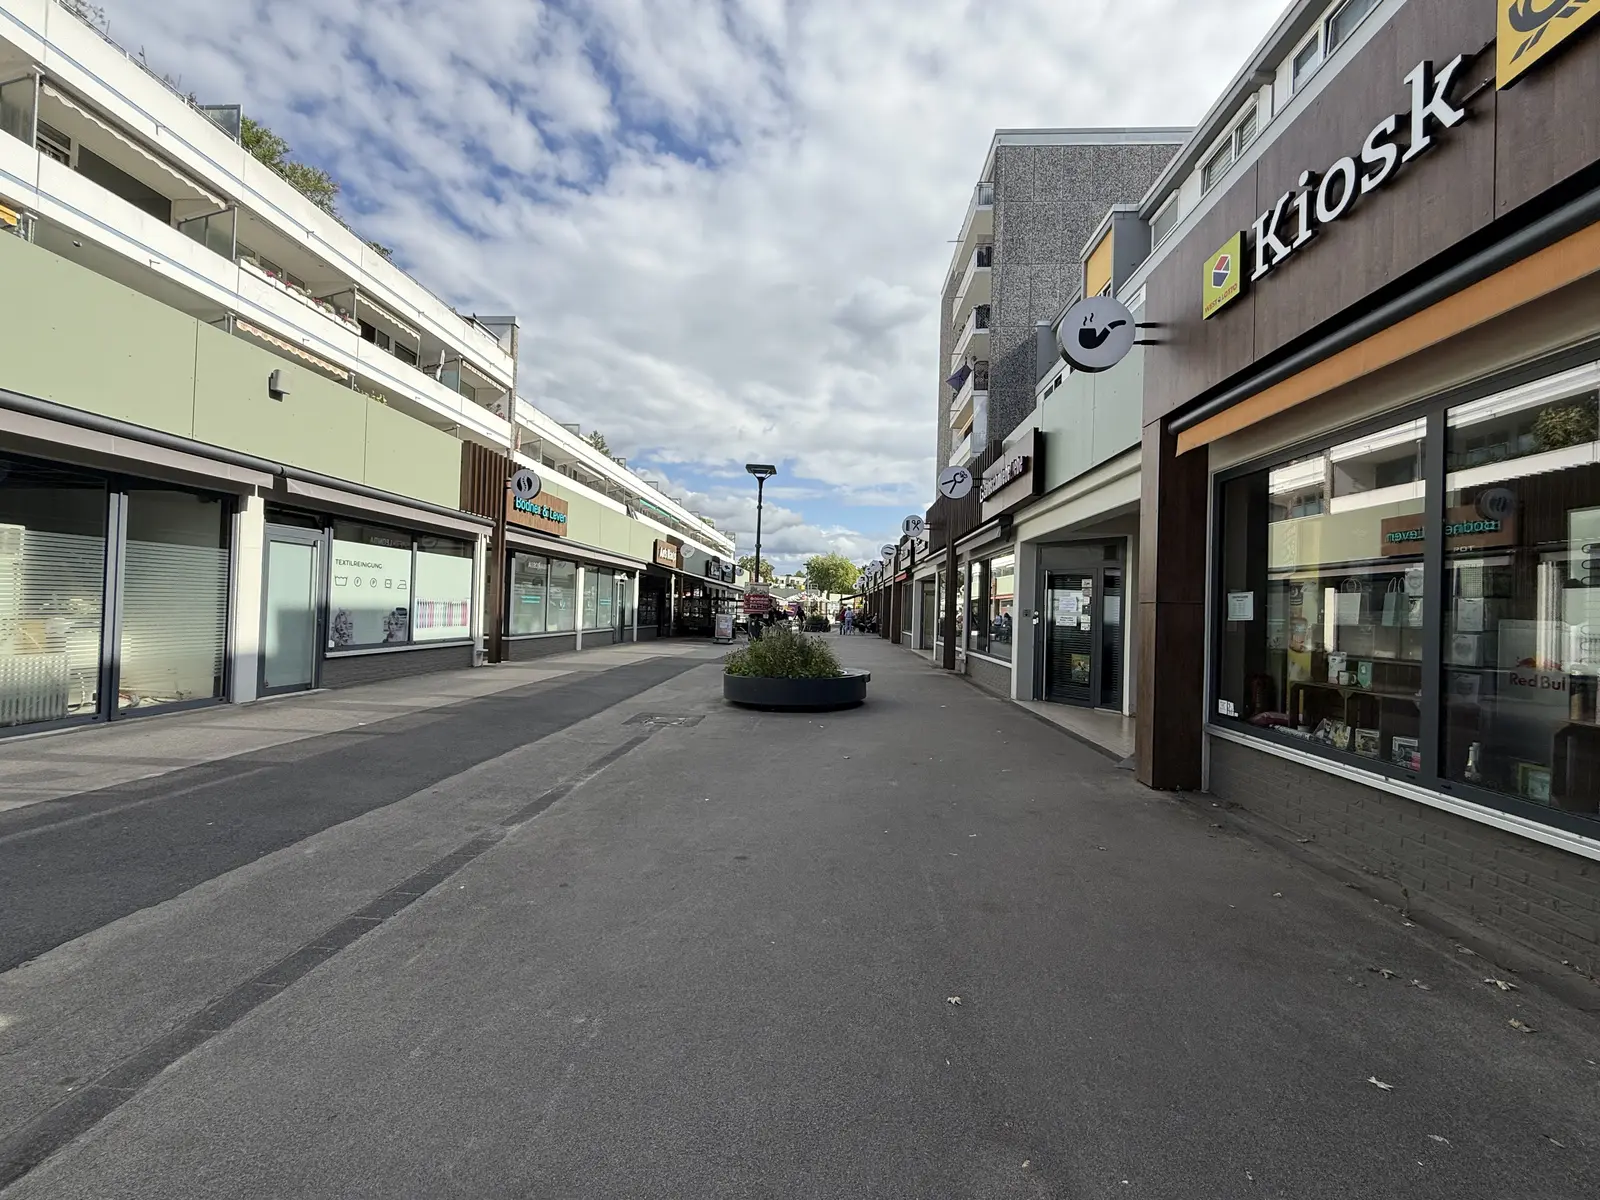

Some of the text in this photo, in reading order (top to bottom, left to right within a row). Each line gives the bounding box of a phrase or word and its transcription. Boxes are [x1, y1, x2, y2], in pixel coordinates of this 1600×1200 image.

[1250, 54, 1470, 282] Kiosk
[335, 558, 383, 570] TEXTILREINIGUNG
[1509, 672, 1566, 692] Red Bul
